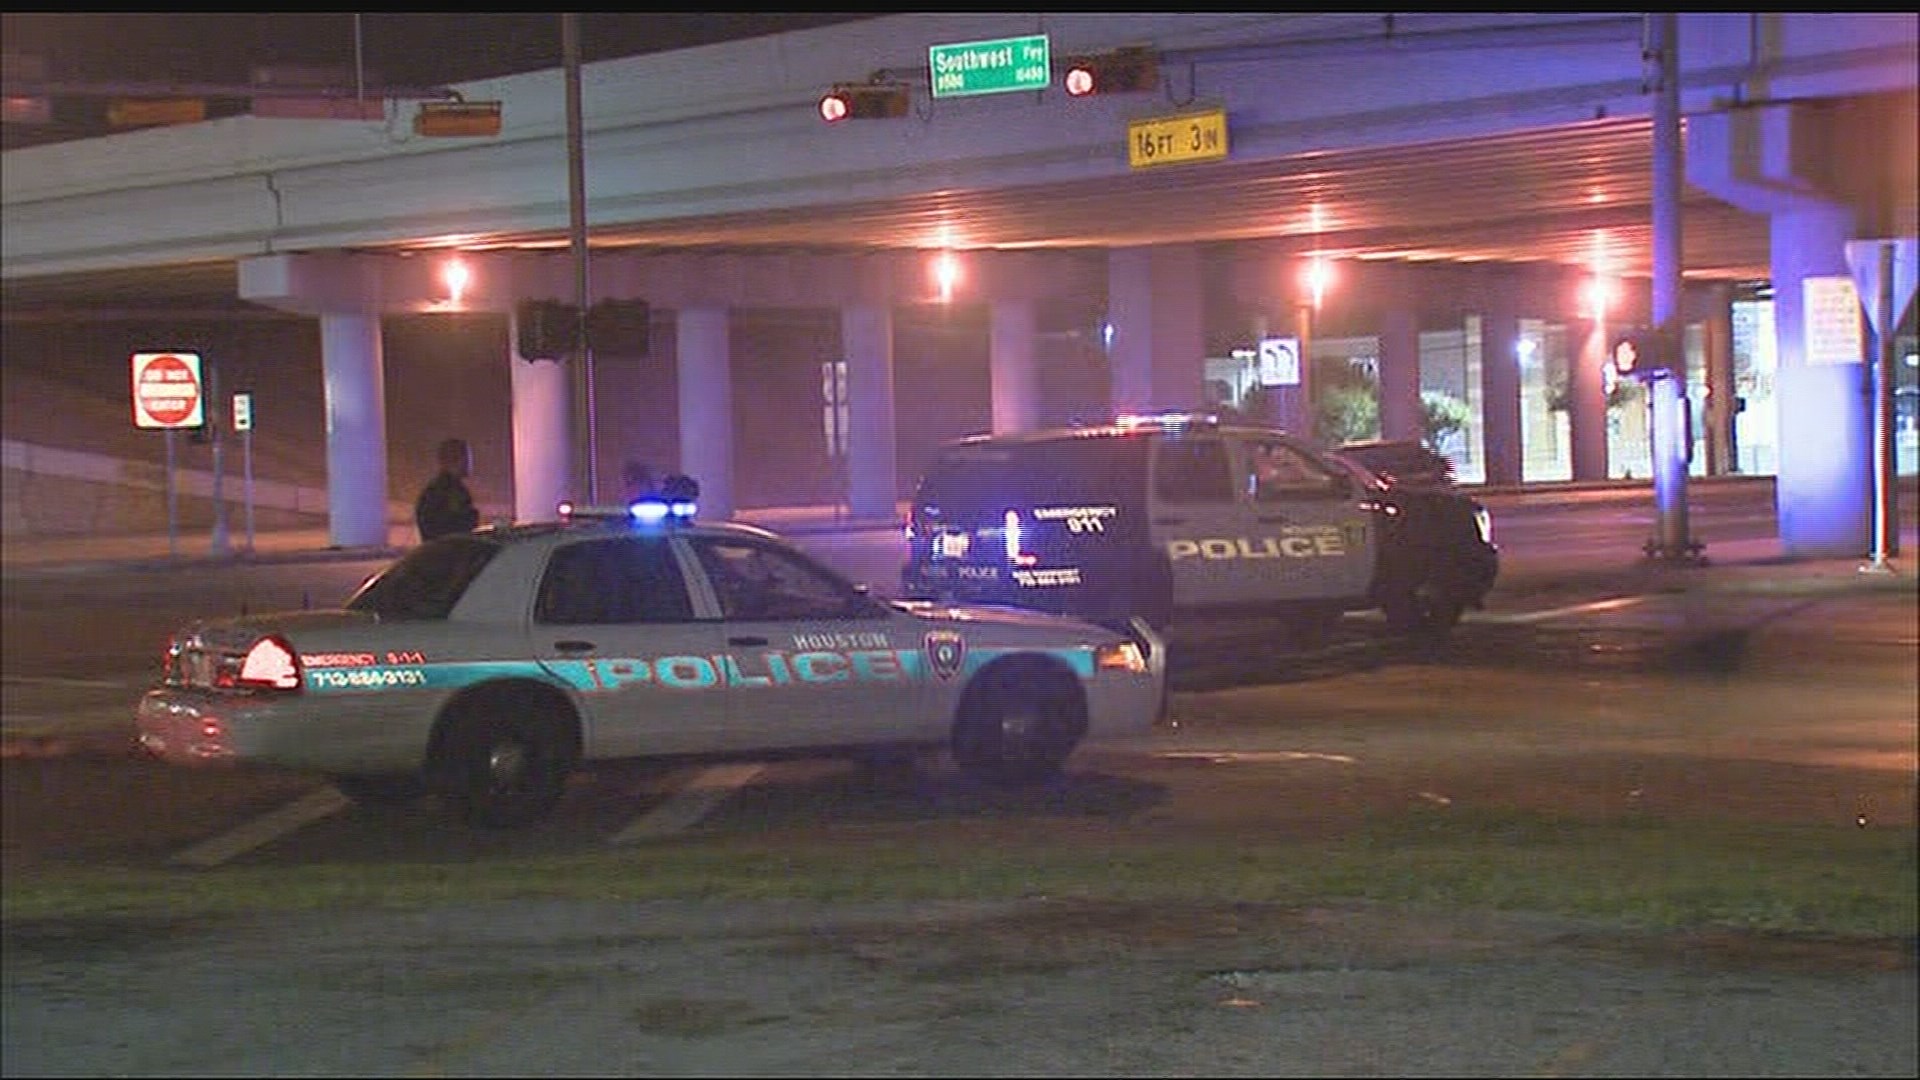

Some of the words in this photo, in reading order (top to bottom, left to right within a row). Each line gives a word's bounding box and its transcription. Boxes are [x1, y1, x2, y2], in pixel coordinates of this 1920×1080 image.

[936, 46, 1013, 73] Southwest
[1190, 125, 1201, 151] 3
[1168, 537, 1345, 560] POLICE
[792, 632, 888, 649] HOUSTON
[596, 650, 900, 691] POLICE
